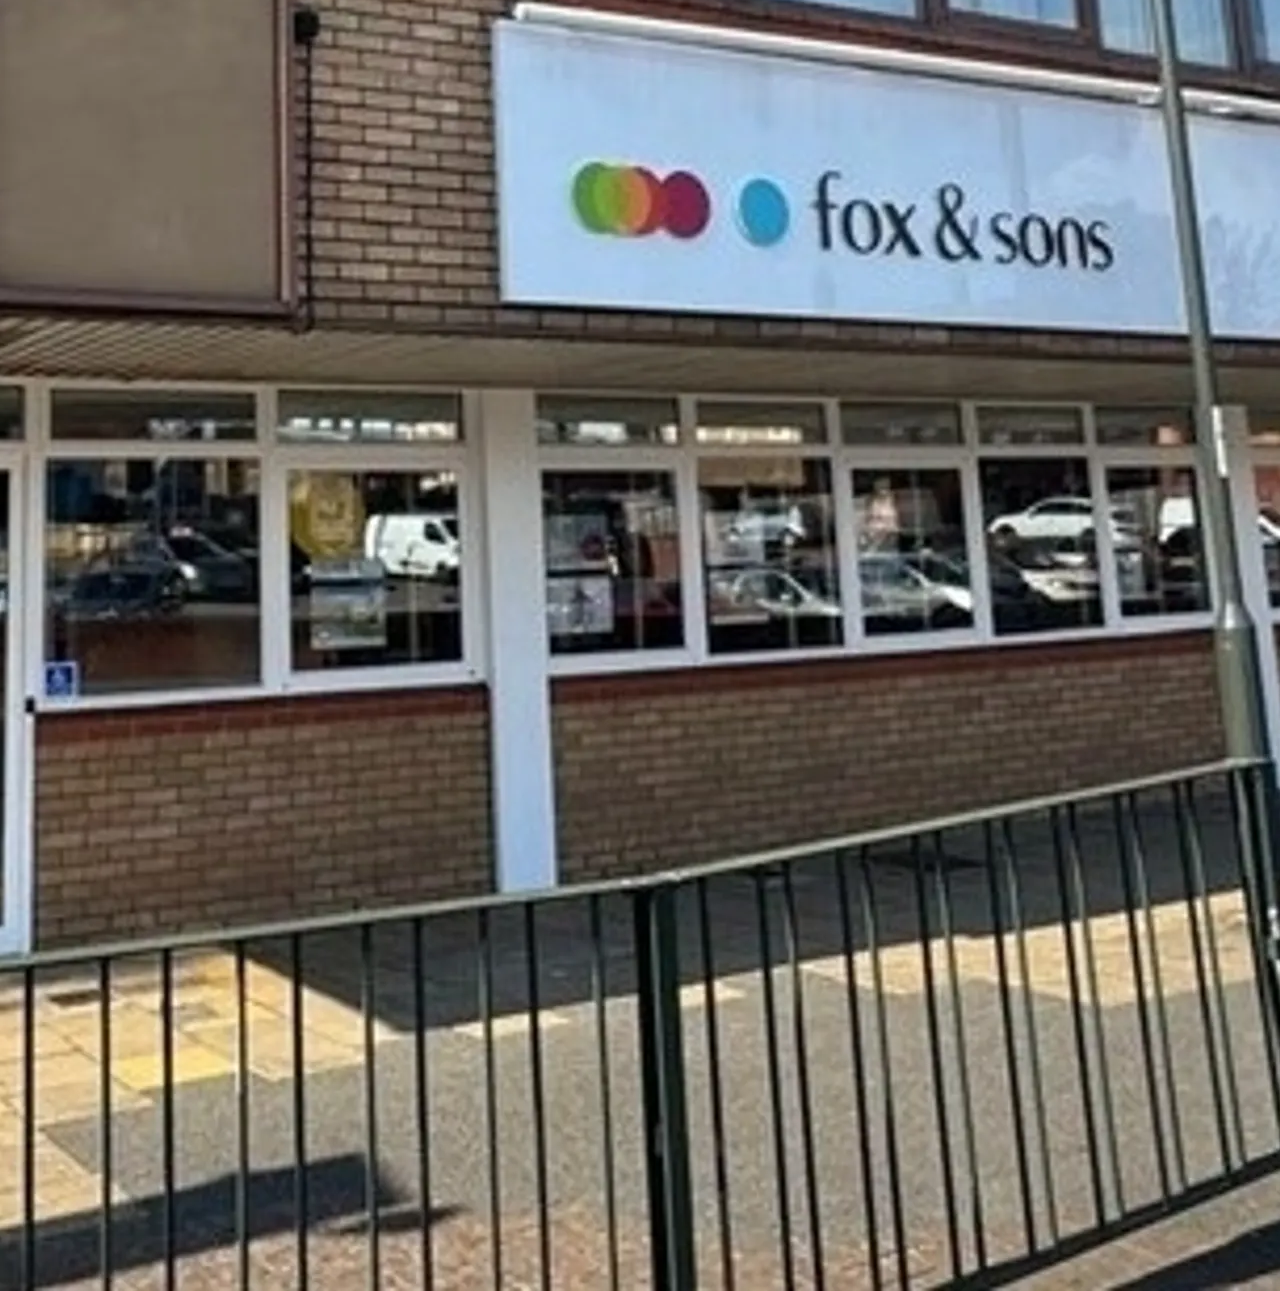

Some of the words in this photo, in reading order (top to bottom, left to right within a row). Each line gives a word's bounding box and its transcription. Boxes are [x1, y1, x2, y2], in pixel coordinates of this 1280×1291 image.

[810, 169, 922, 257] fox
[934, 182, 982, 262] &
[989, 210, 1115, 272] sons
